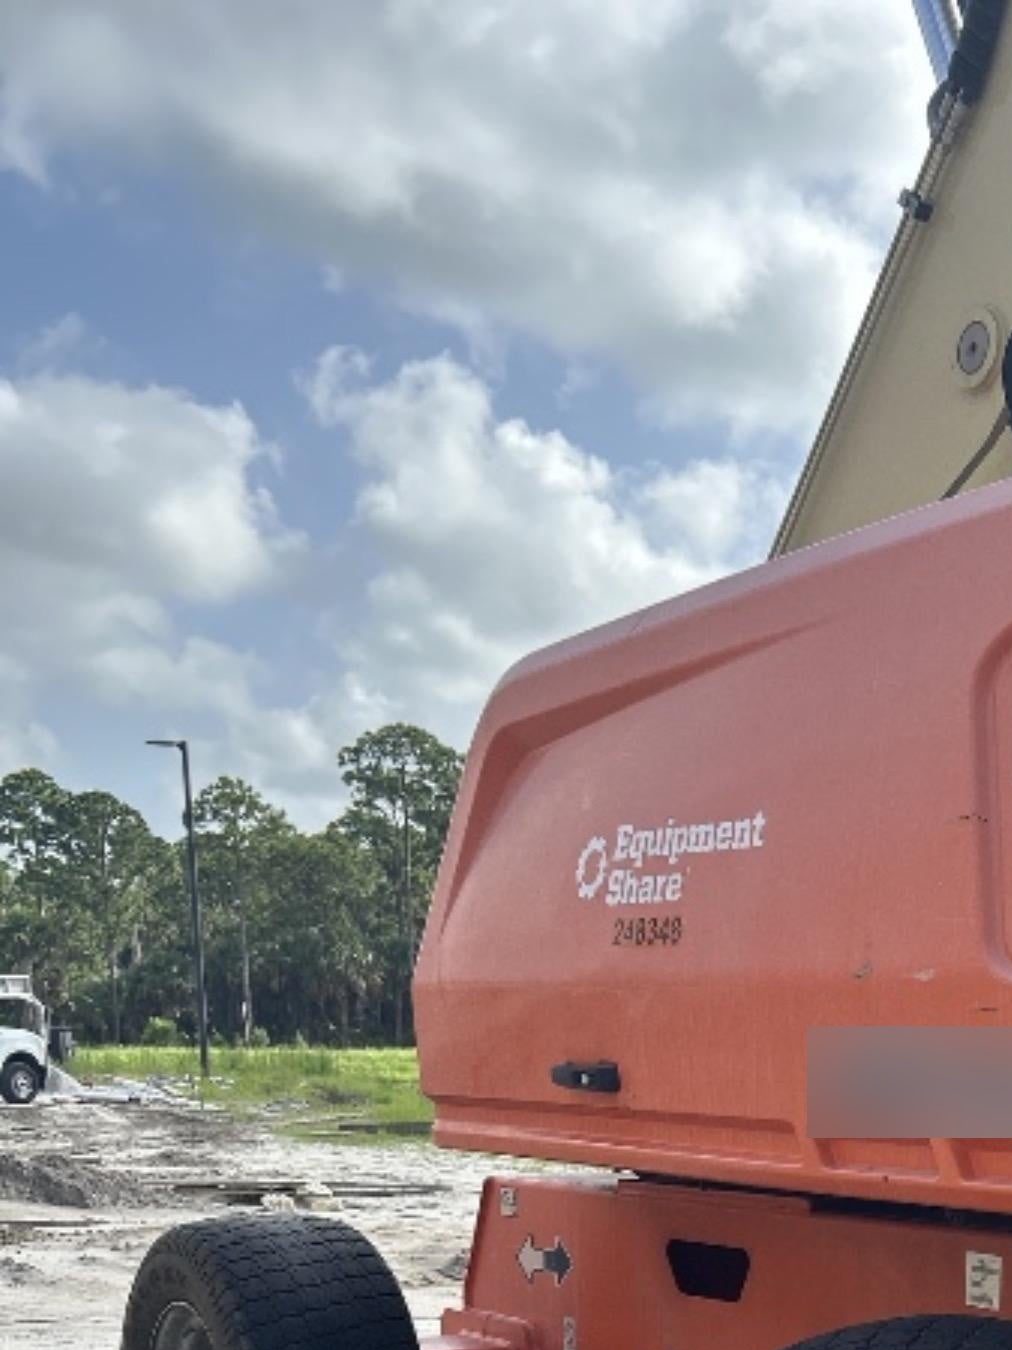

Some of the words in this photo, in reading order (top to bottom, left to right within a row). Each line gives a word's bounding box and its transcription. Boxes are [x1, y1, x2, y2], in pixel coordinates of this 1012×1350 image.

[613, 811, 766, 867] Equipment
[606, 868, 682, 906] Share
[613, 917, 682, 945] 248348
